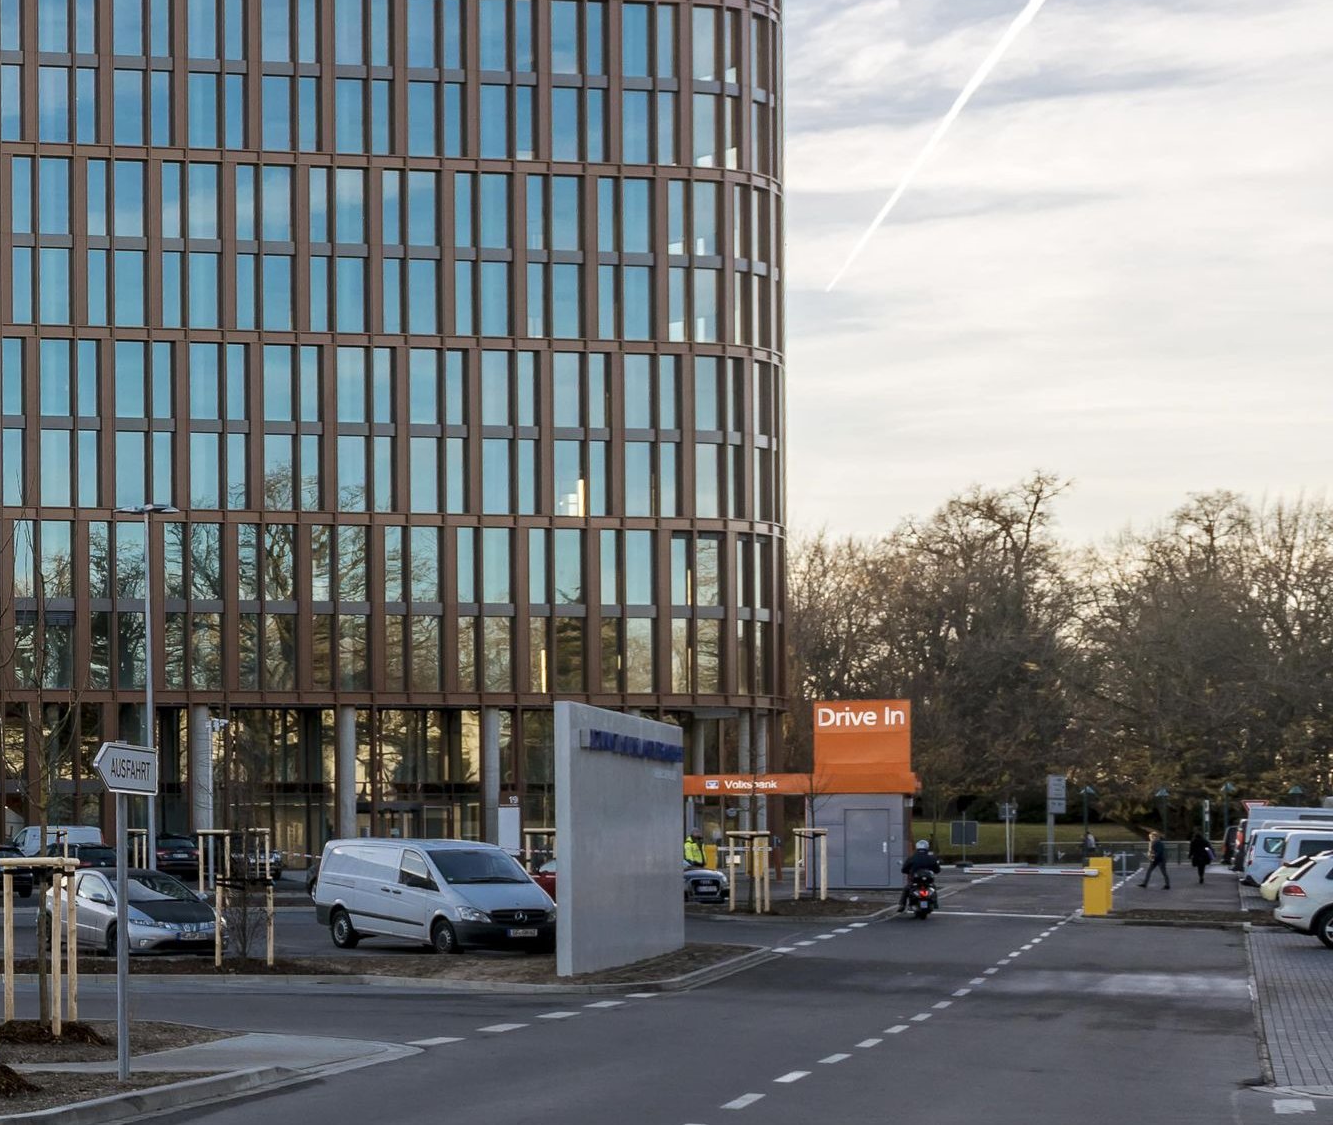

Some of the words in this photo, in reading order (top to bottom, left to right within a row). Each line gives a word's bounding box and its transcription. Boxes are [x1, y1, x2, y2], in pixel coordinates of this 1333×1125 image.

[818, 706, 878, 727] Drive
[884, 706, 905, 725] In
[110, 757, 151, 782] AUSFAHRT
